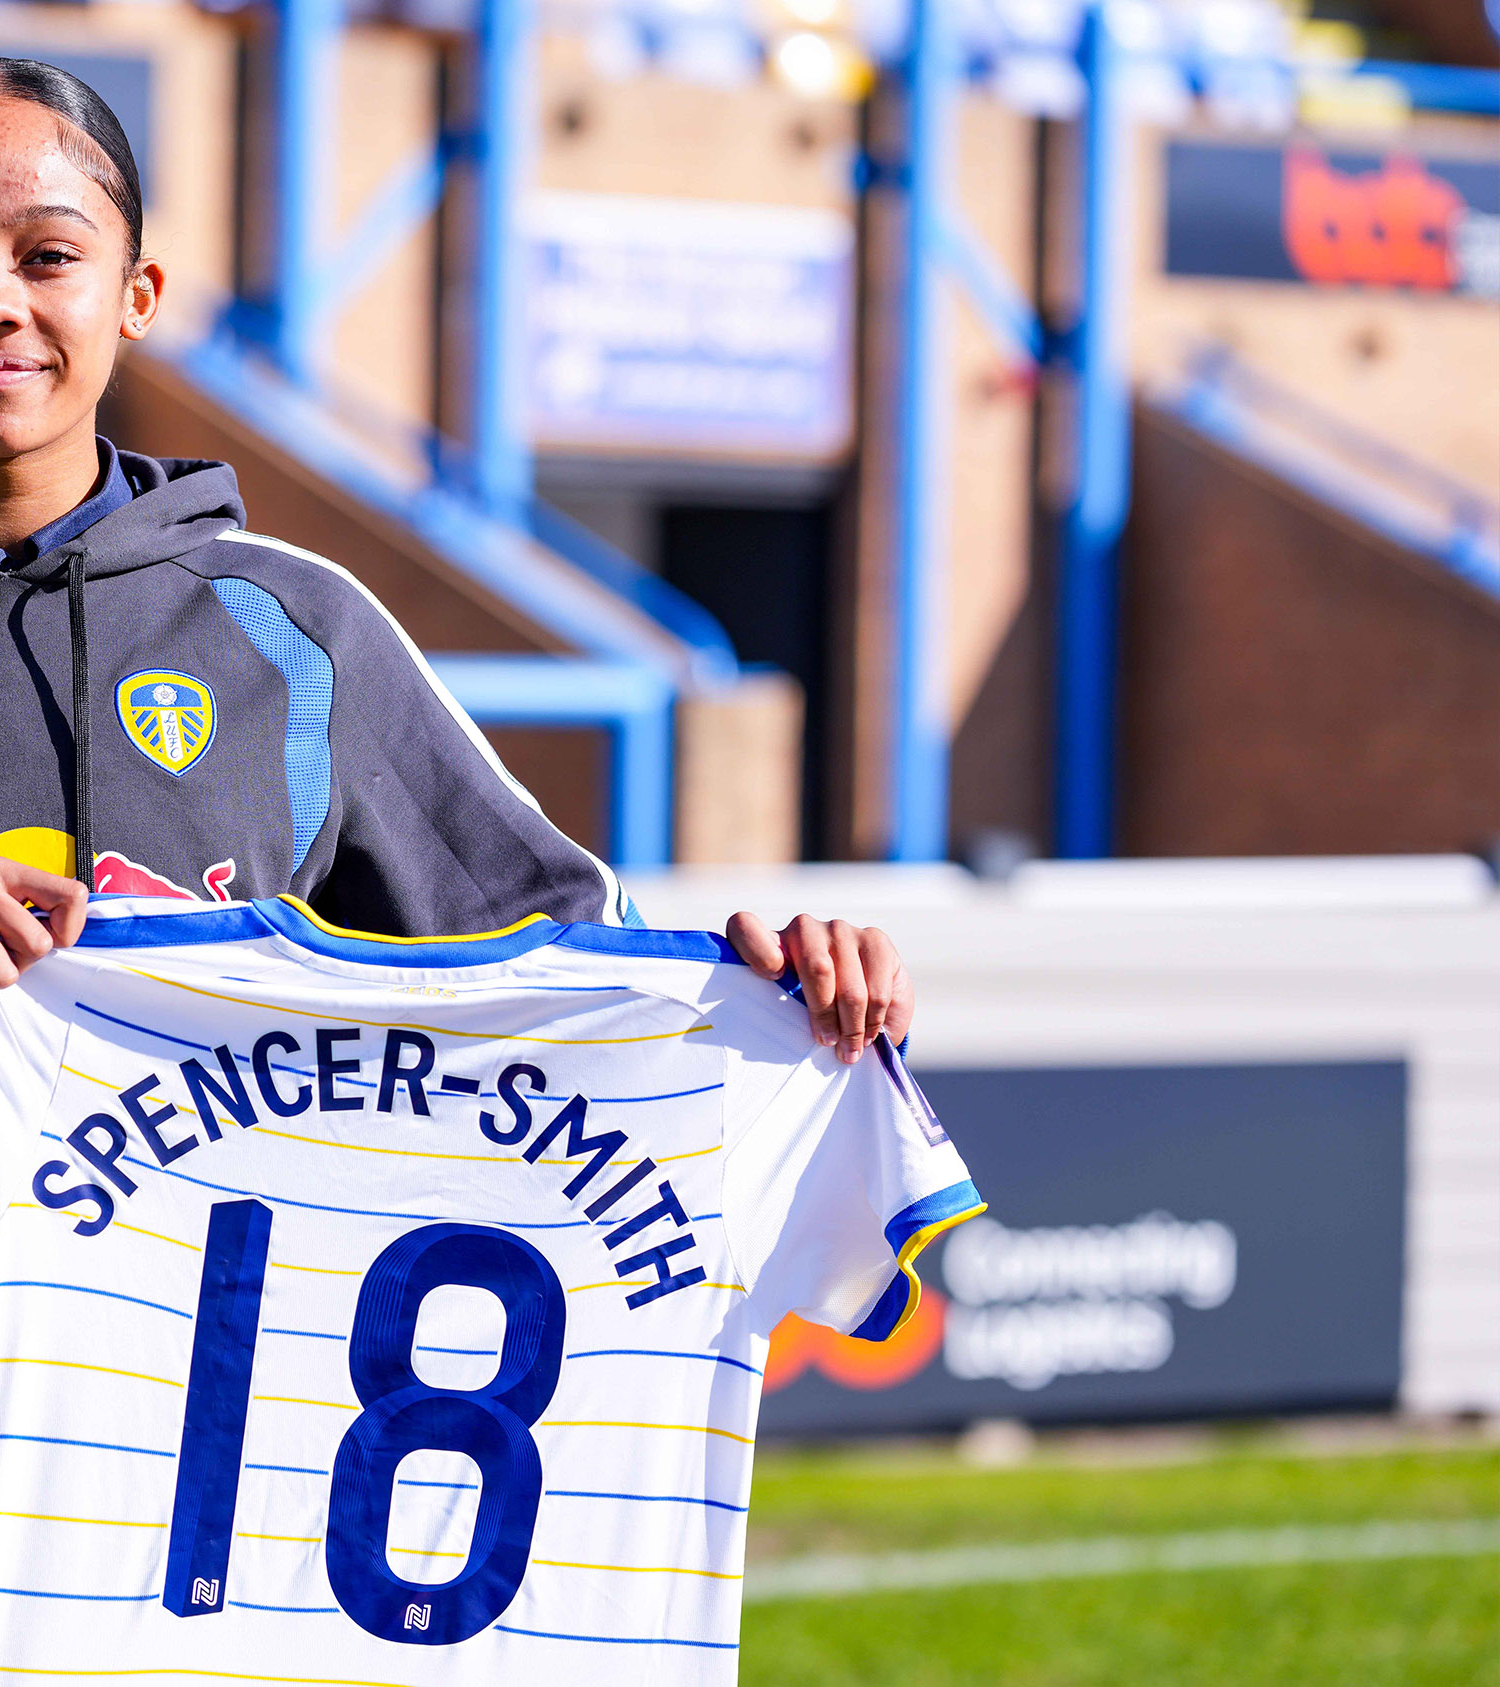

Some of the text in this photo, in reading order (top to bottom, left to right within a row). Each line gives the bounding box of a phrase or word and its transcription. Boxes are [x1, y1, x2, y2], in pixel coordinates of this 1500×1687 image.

[163, 711, 179, 759] LUFC
[30, 1026, 708, 1312] SPENCER-SMITH
[161, 1198, 568, 1647] 18
